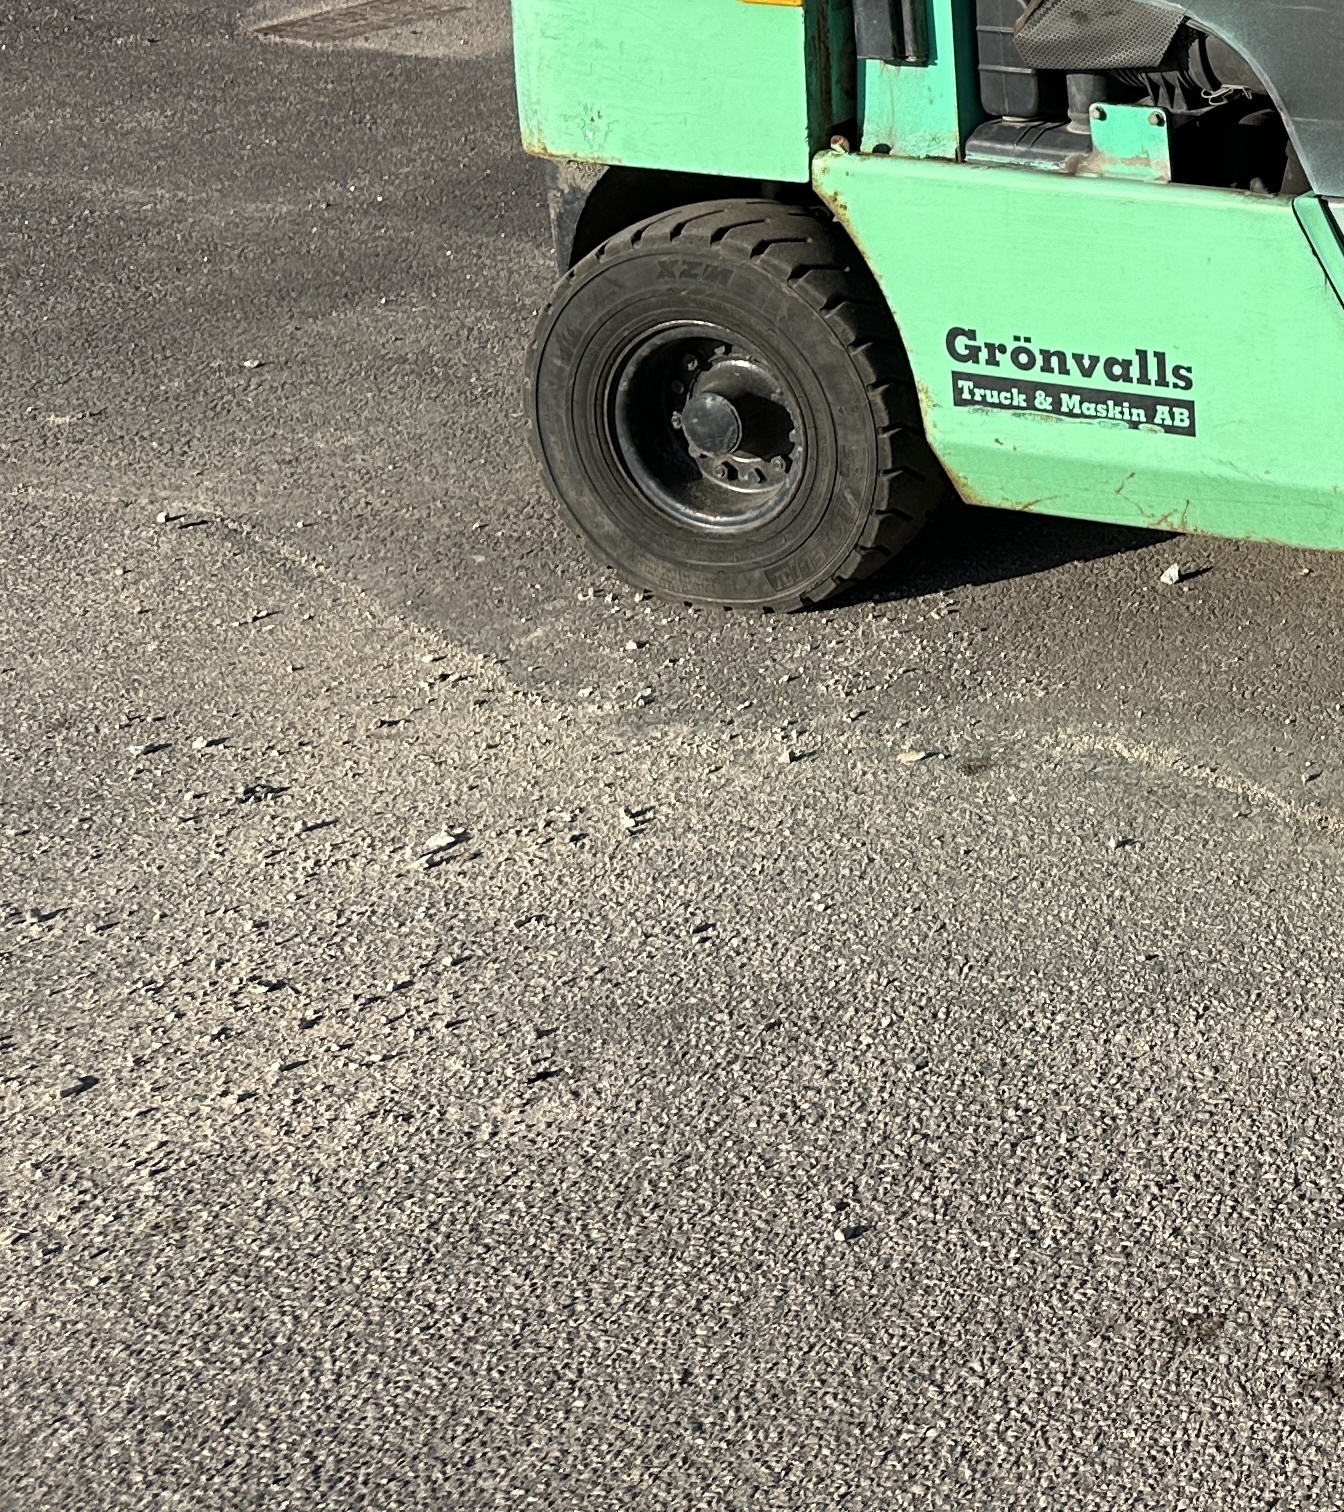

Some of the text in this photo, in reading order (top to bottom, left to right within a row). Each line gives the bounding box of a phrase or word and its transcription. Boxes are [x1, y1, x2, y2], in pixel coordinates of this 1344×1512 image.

[655, 259, 736, 287] XZM
[945, 326, 1194, 391] Grönvalls
[957, 380, 1191, 427] Truck & Maskin AB
